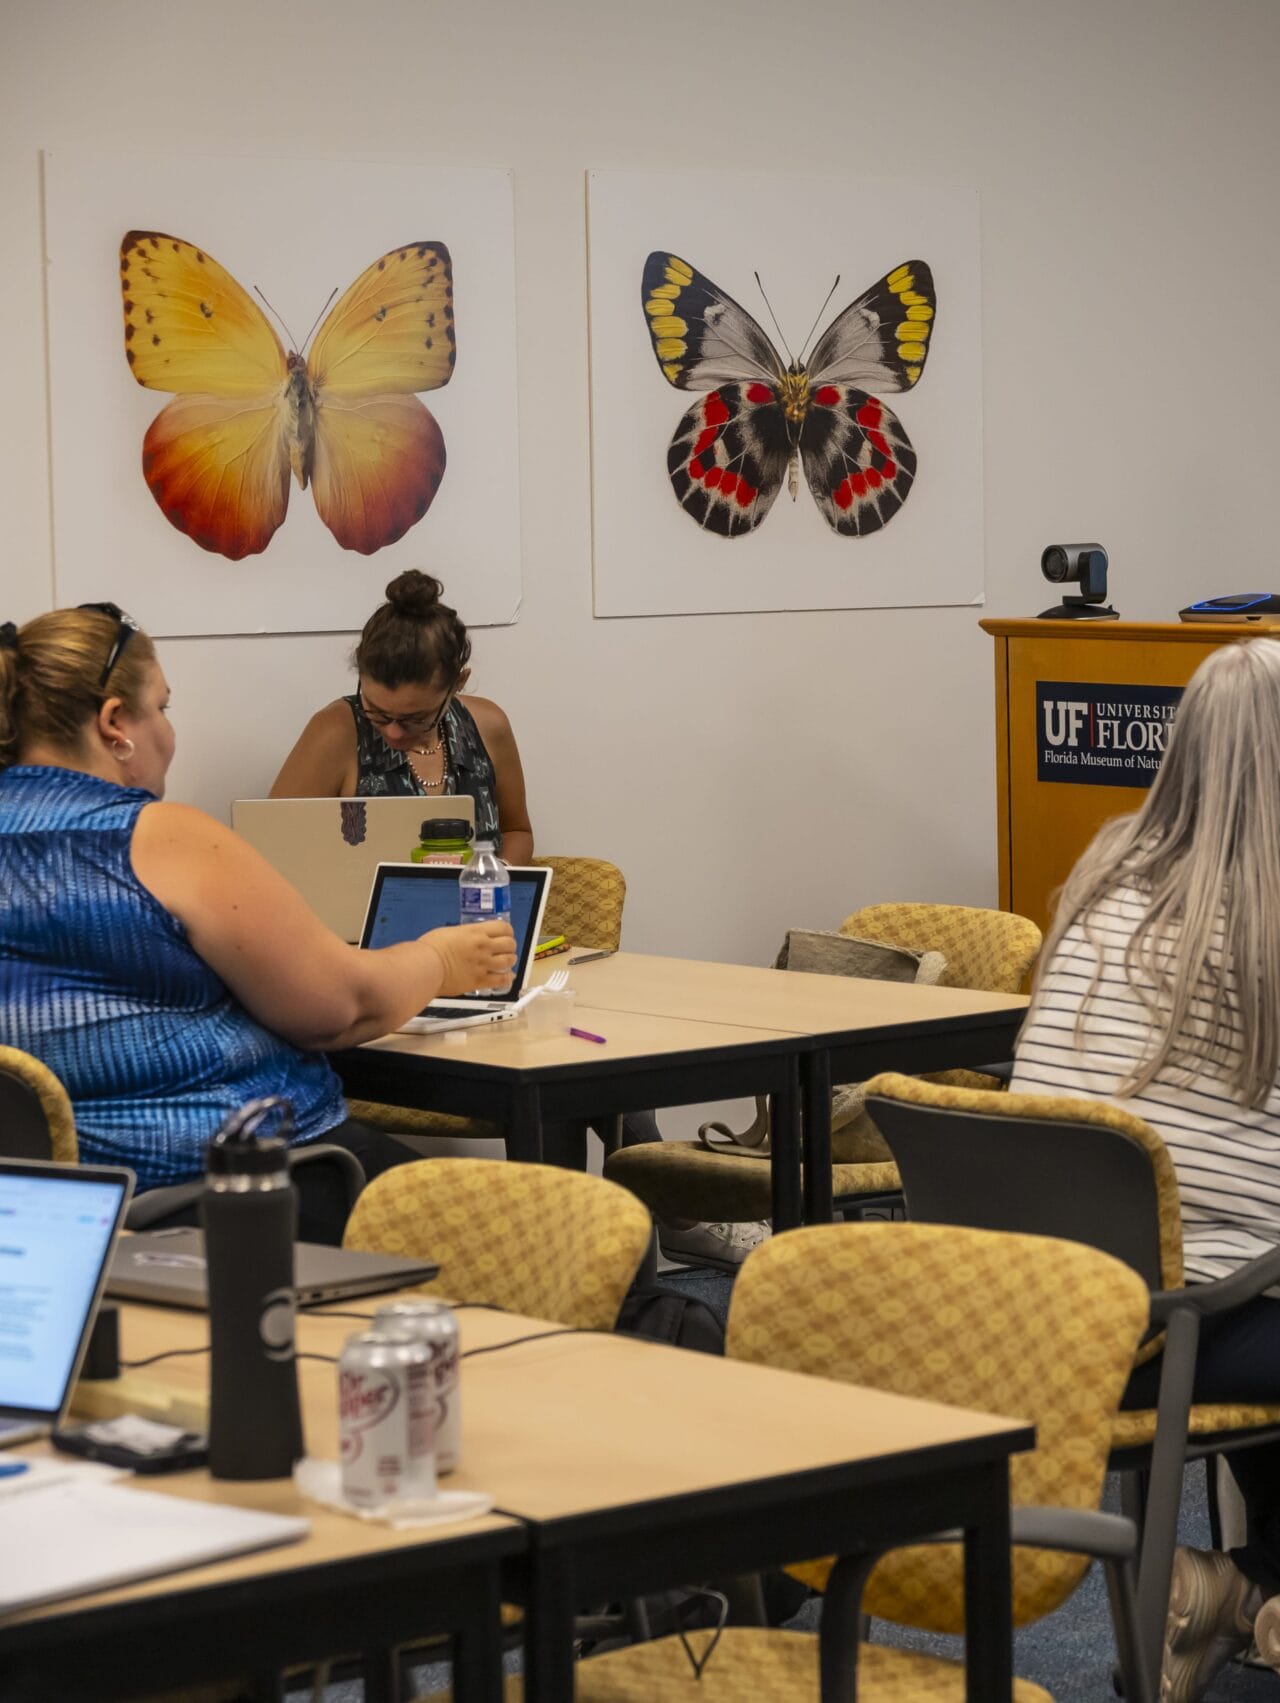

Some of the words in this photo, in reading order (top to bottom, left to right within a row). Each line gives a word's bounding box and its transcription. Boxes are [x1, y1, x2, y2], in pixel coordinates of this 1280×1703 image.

[1043, 700, 1089, 747] UF
[1096, 702, 1177, 719] UNIVERSIT
[1096, 719, 1176, 752] FLORI
[1044, 750, 1078, 765] Florida
[1080, 752, 1123, 768] Museum
[1124, 755, 1136, 768] of
[1137, 755, 1164, 770] Natu
